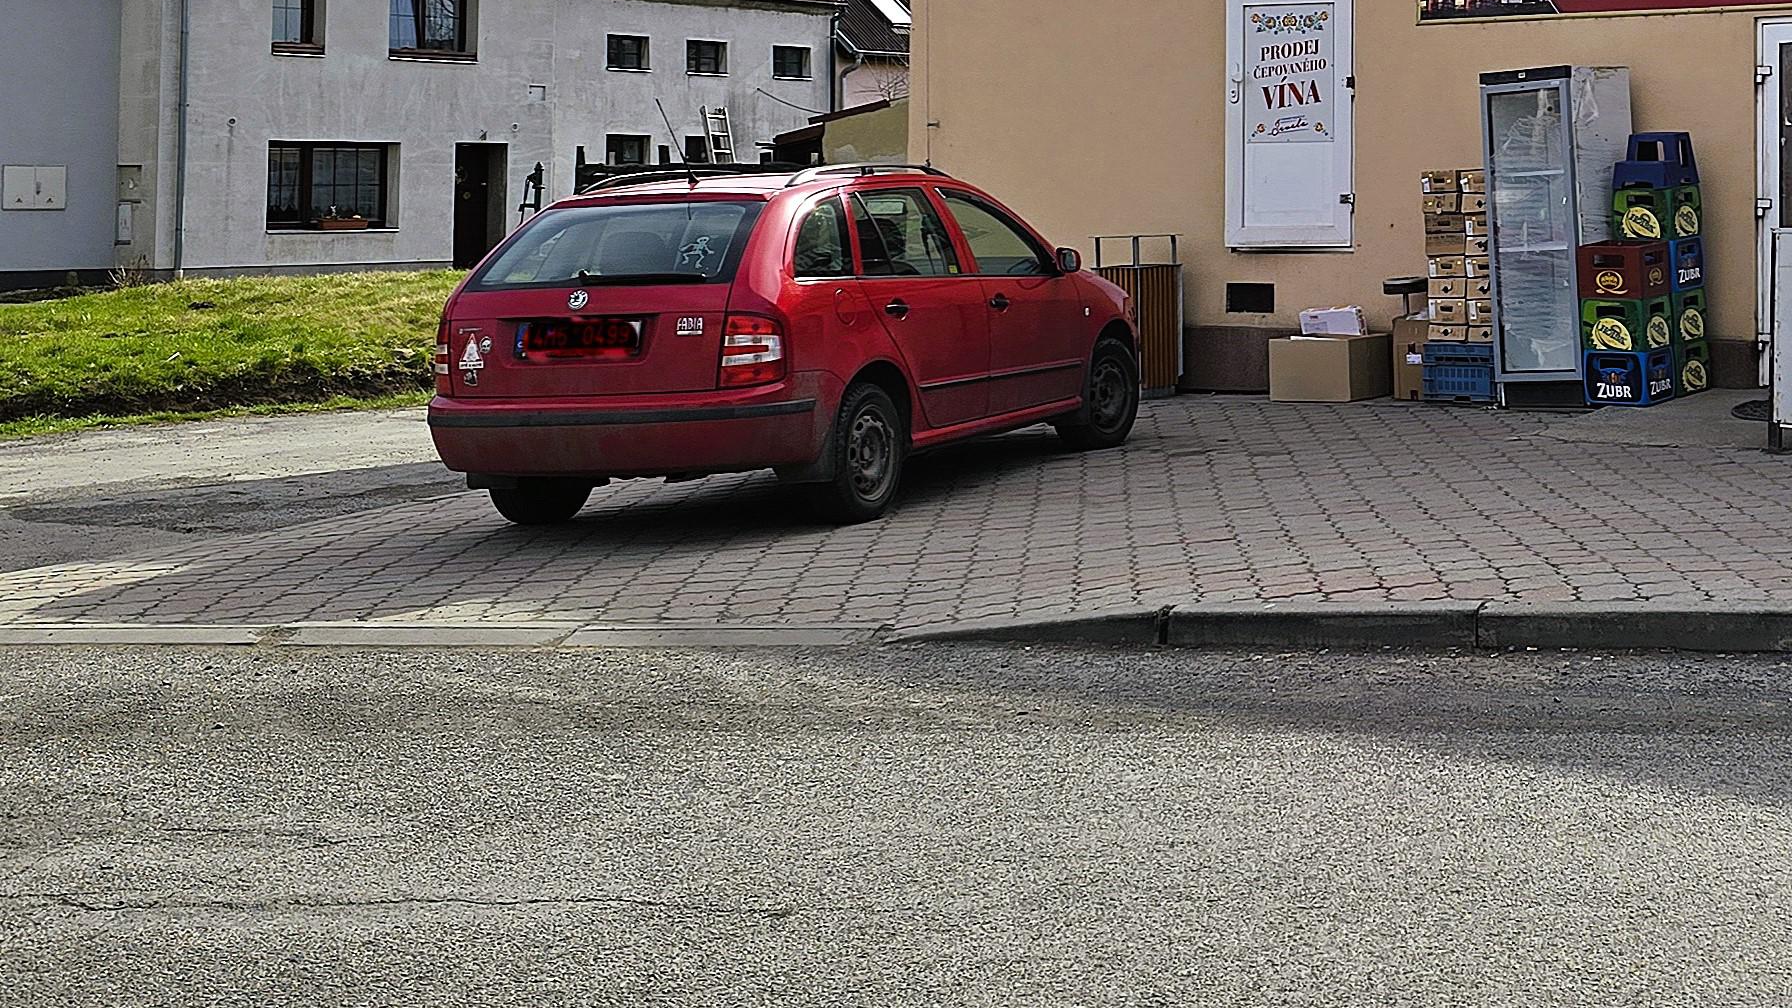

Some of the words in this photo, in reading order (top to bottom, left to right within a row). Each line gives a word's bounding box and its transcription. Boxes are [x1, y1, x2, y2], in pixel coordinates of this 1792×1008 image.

[1261, 39, 1320, 61] PRODEJ
[1253, 58, 1327, 79] ČEPOVANÉHO
[1261, 76, 1322, 110] VÍNA
[1678, 268, 1701, 283] ZUBR
[676, 317, 703, 331] FABIA
[1596, 382, 1632, 399] ZUBR
[1650, 378, 1672, 396] ZUBR
